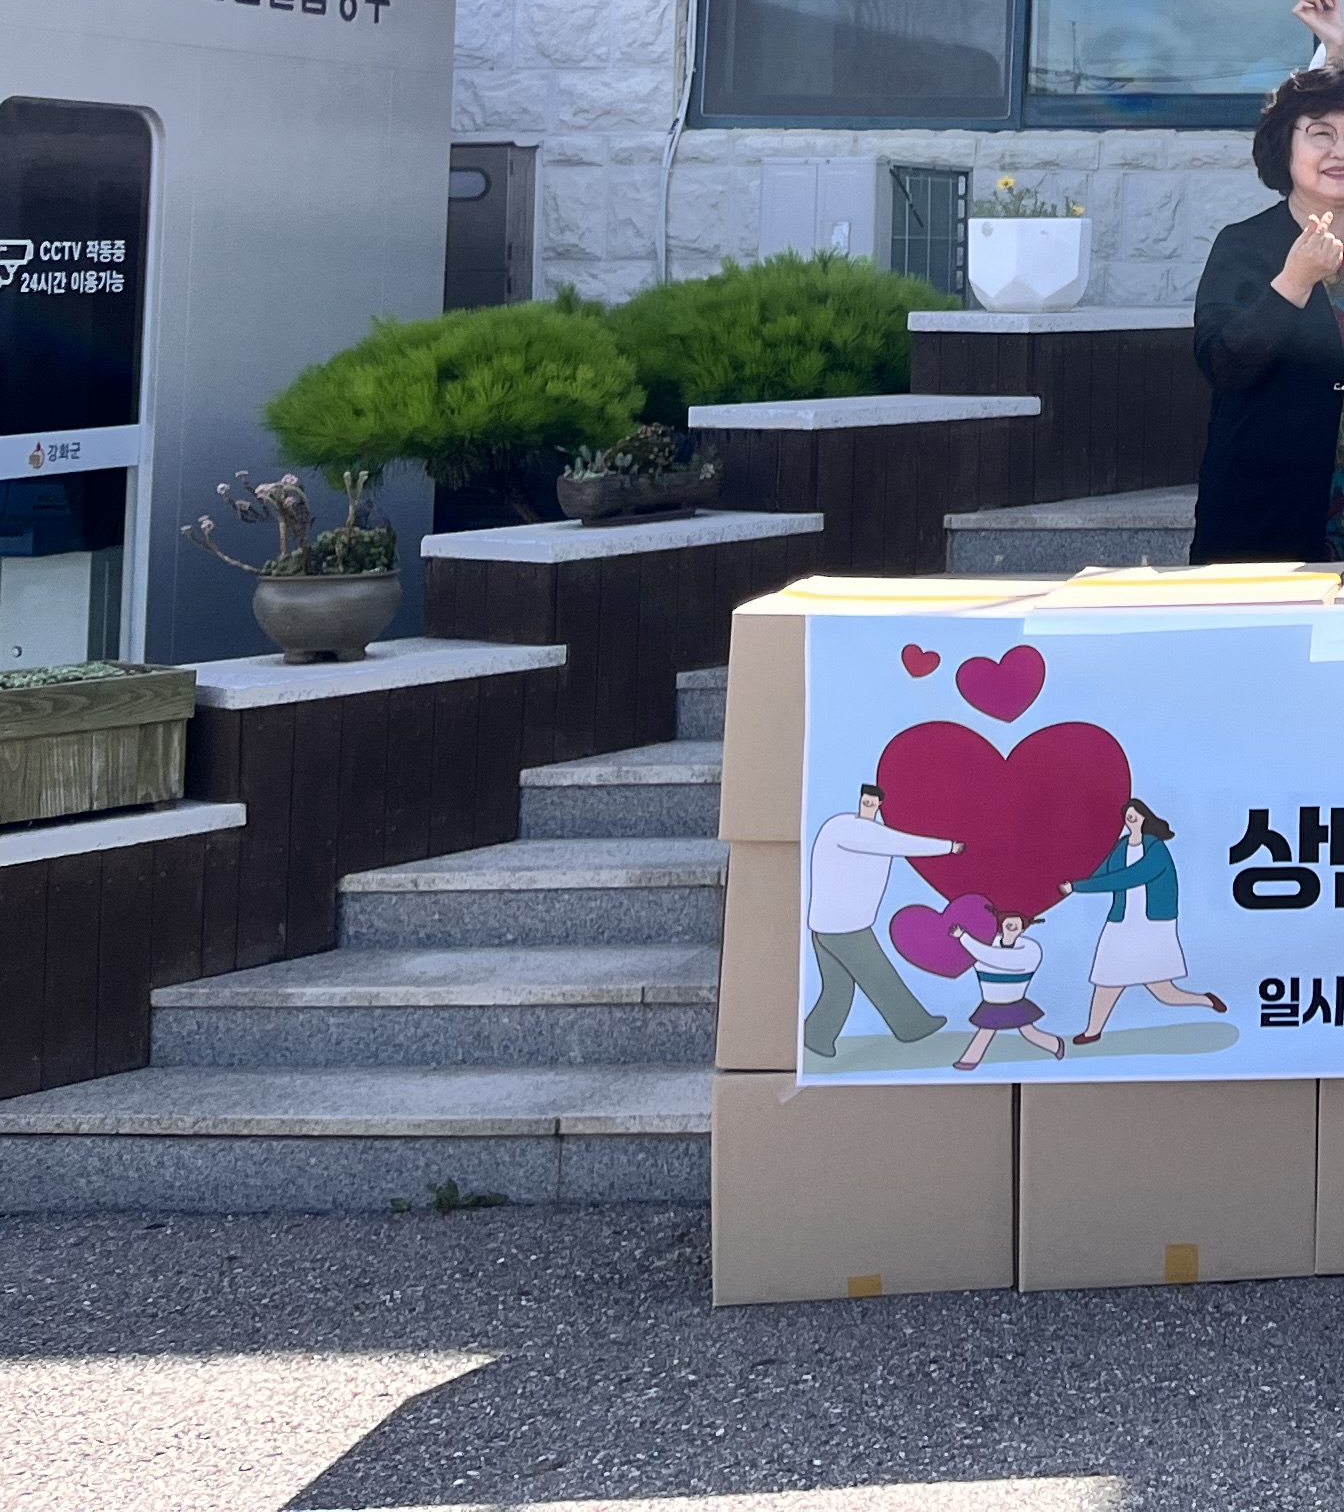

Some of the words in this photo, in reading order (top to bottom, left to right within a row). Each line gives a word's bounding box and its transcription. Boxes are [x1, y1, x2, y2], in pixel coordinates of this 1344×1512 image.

[40, 241, 81, 261] CCTV
[20, 271, 67, 295] 24시간
[71, 270, 125, 294] 이용가능
[47, 441, 81, 462] 강화군
